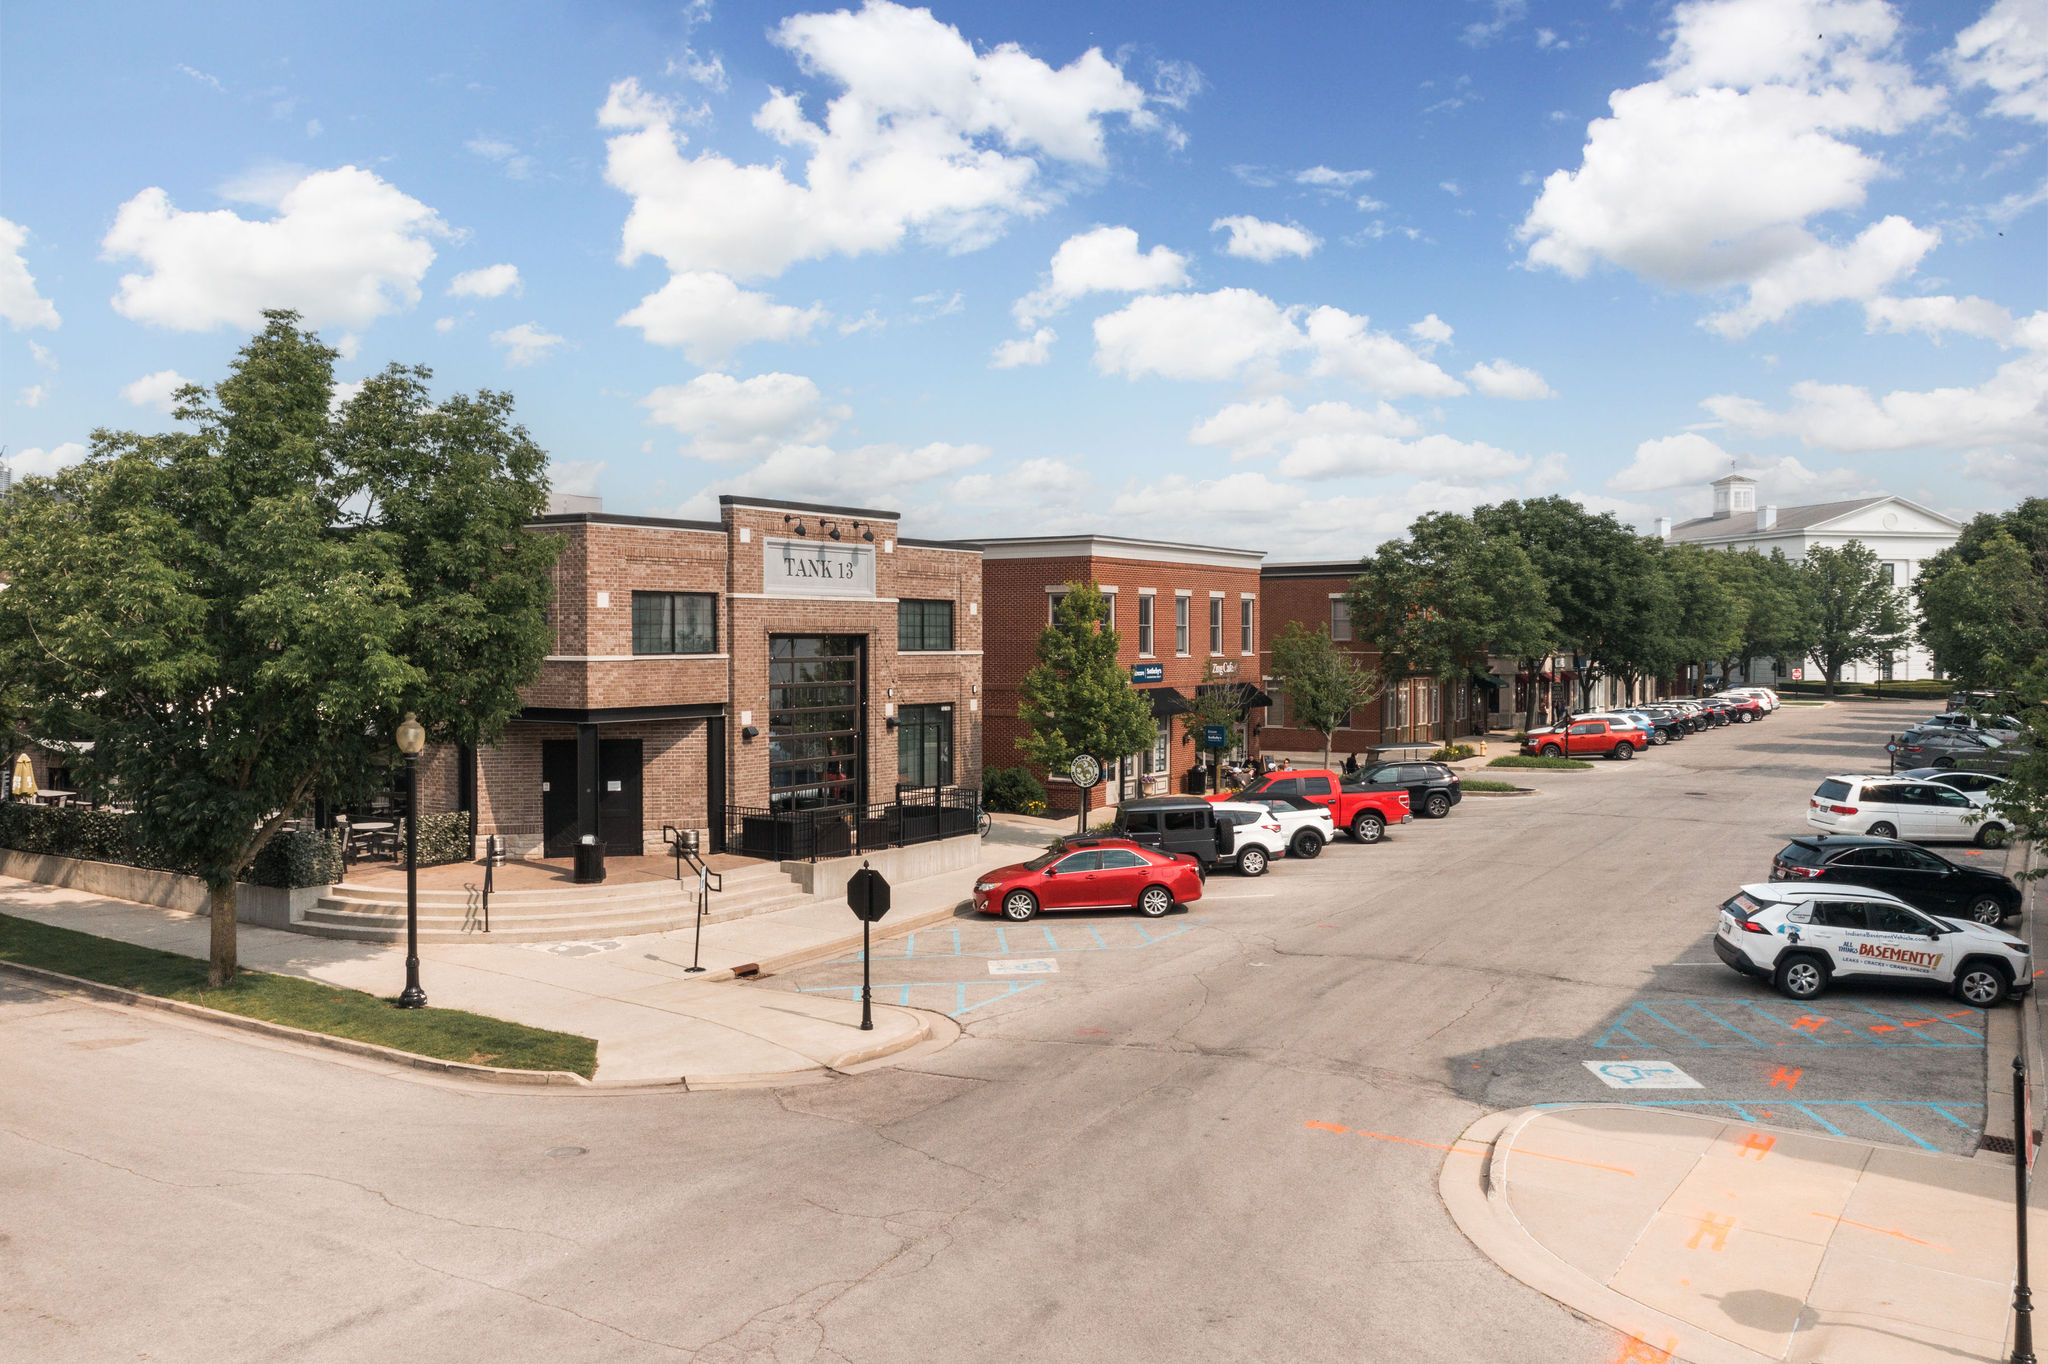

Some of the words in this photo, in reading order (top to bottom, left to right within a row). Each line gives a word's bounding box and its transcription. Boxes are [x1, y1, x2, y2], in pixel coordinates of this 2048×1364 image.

[783, 558, 833, 578] TANK
[838, 562, 854, 580] 13
[1212, 663, 1224, 676] Zing
[1838, 946, 1859, 954] THINGS
[1859, 943, 1944, 970] BASEMENTY!
[1864, 960, 1885, 968] CRACKS
[1889, 963, 1908, 971] CRAWL
